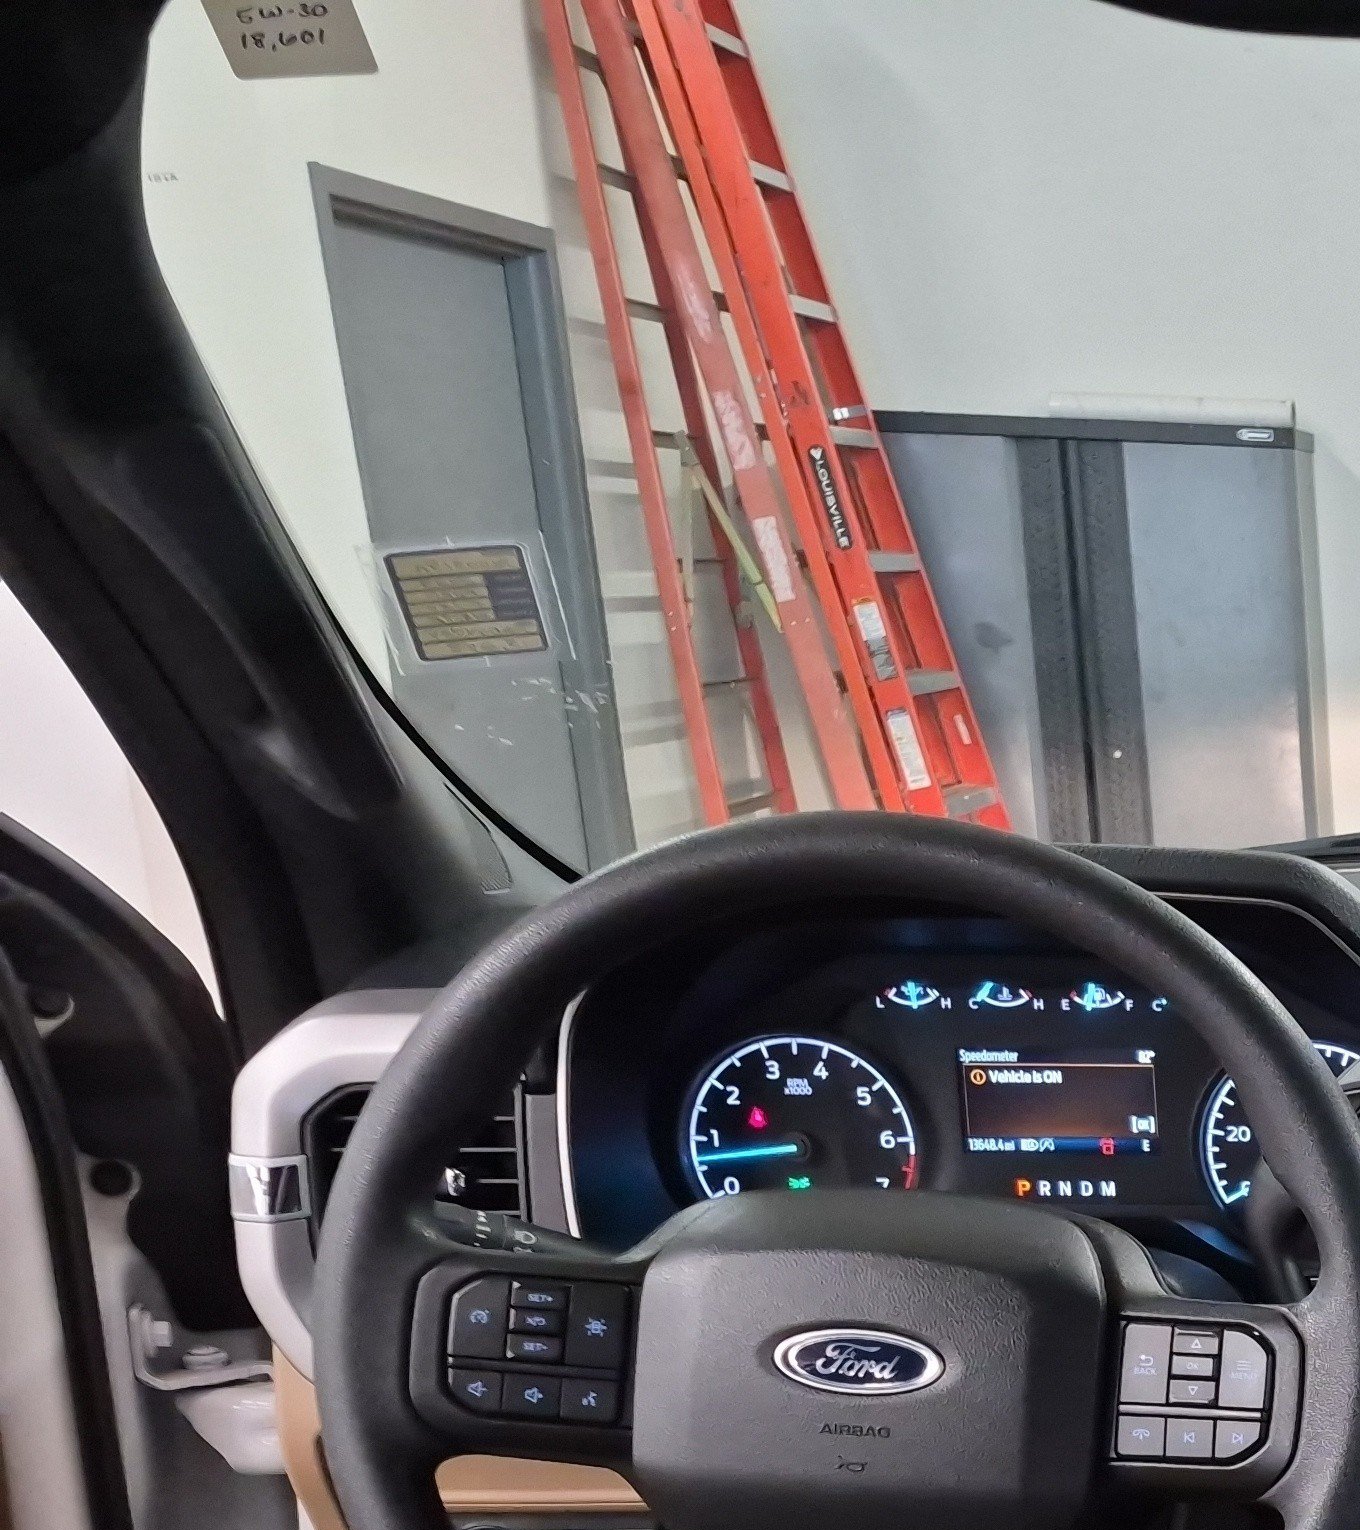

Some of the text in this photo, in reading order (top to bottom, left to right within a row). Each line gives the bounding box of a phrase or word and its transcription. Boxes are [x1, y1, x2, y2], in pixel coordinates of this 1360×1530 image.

[241, 27, 325, 52] 18,601
[815, 460, 851, 548] LOUISVILLE
[875, 997, 885, 1009] L
[940, 998, 951, 1010] H
[968, 997, 979, 1010] C
[1033, 998, 1044, 1011] H
[1061, 999, 1071, 1011] E
[1124, 999, 1134, 1011] F
[959, 1049, 1019, 1063] Speedometer
[765, 1060, 780, 1080] 3
[812, 1060, 829, 1080] 4
[988, 1069, 1032, 1084] Vehicle
[1043, 1070, 1063, 1084] ON
[783, 1085, 813, 1096] x1000
[786, 1077, 809, 1088] RPM
[725, 1085, 741, 1105] 2
[856, 1086, 872, 1106] 5
[709, 1128, 720, 1148] 1
[879, 1130, 897, 1149] 6
[1225, 1125, 1251, 1143] 20
[967, 1138, 1003, 1152] 13648.4
[723, 1176, 740, 1195] 0
[1017, 1179, 1031, 1197] P
[1037, 1180, 1051, 1197] R
[1058, 1180, 1072, 1197] N
[1080, 1180, 1093, 1197] D
[1100, 1180, 1116, 1197] M
[814, 1341, 901, 1380] Ford
[1133, 1366, 1158, 1376] BACK
[819, 1422, 891, 1439] AIRBAG
